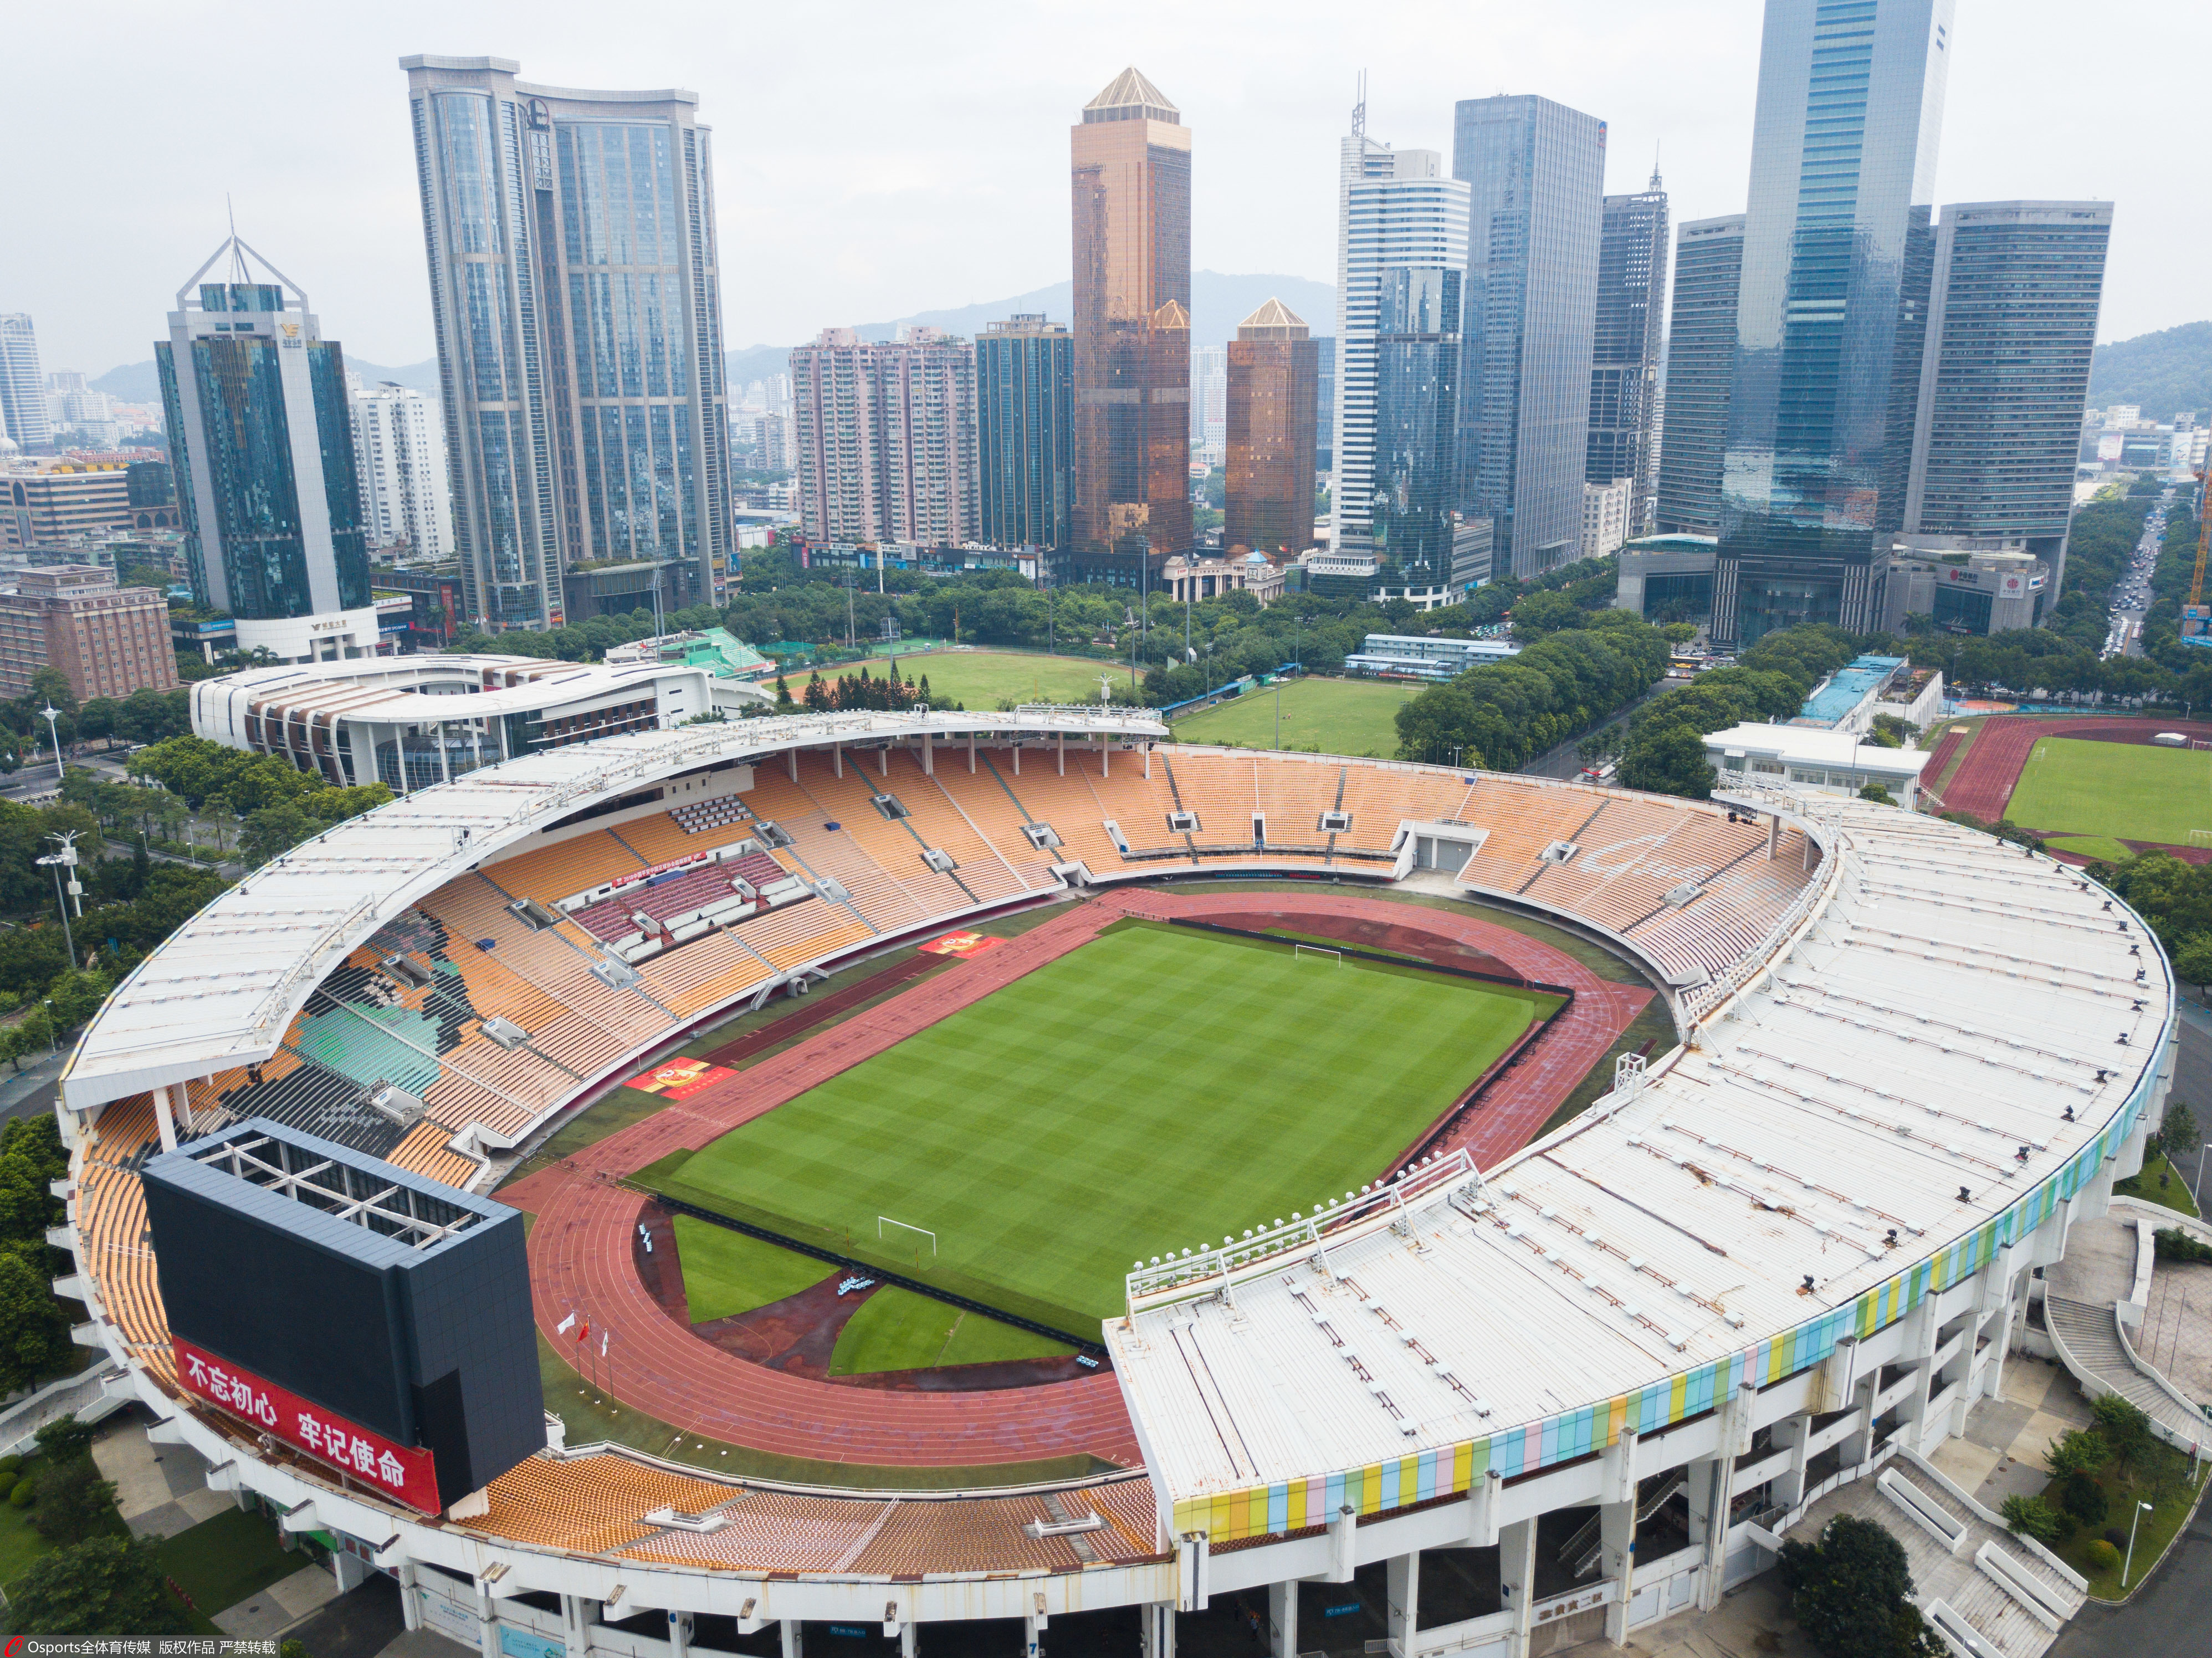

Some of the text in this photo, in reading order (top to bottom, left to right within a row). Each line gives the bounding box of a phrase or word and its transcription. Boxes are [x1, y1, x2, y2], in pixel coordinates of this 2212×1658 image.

[186, 1353, 404, 1487] 不忘初心 牢记使命
[669, 1613, 677, 1623] 6
[1029, 1643, 1037, 1654] 7
